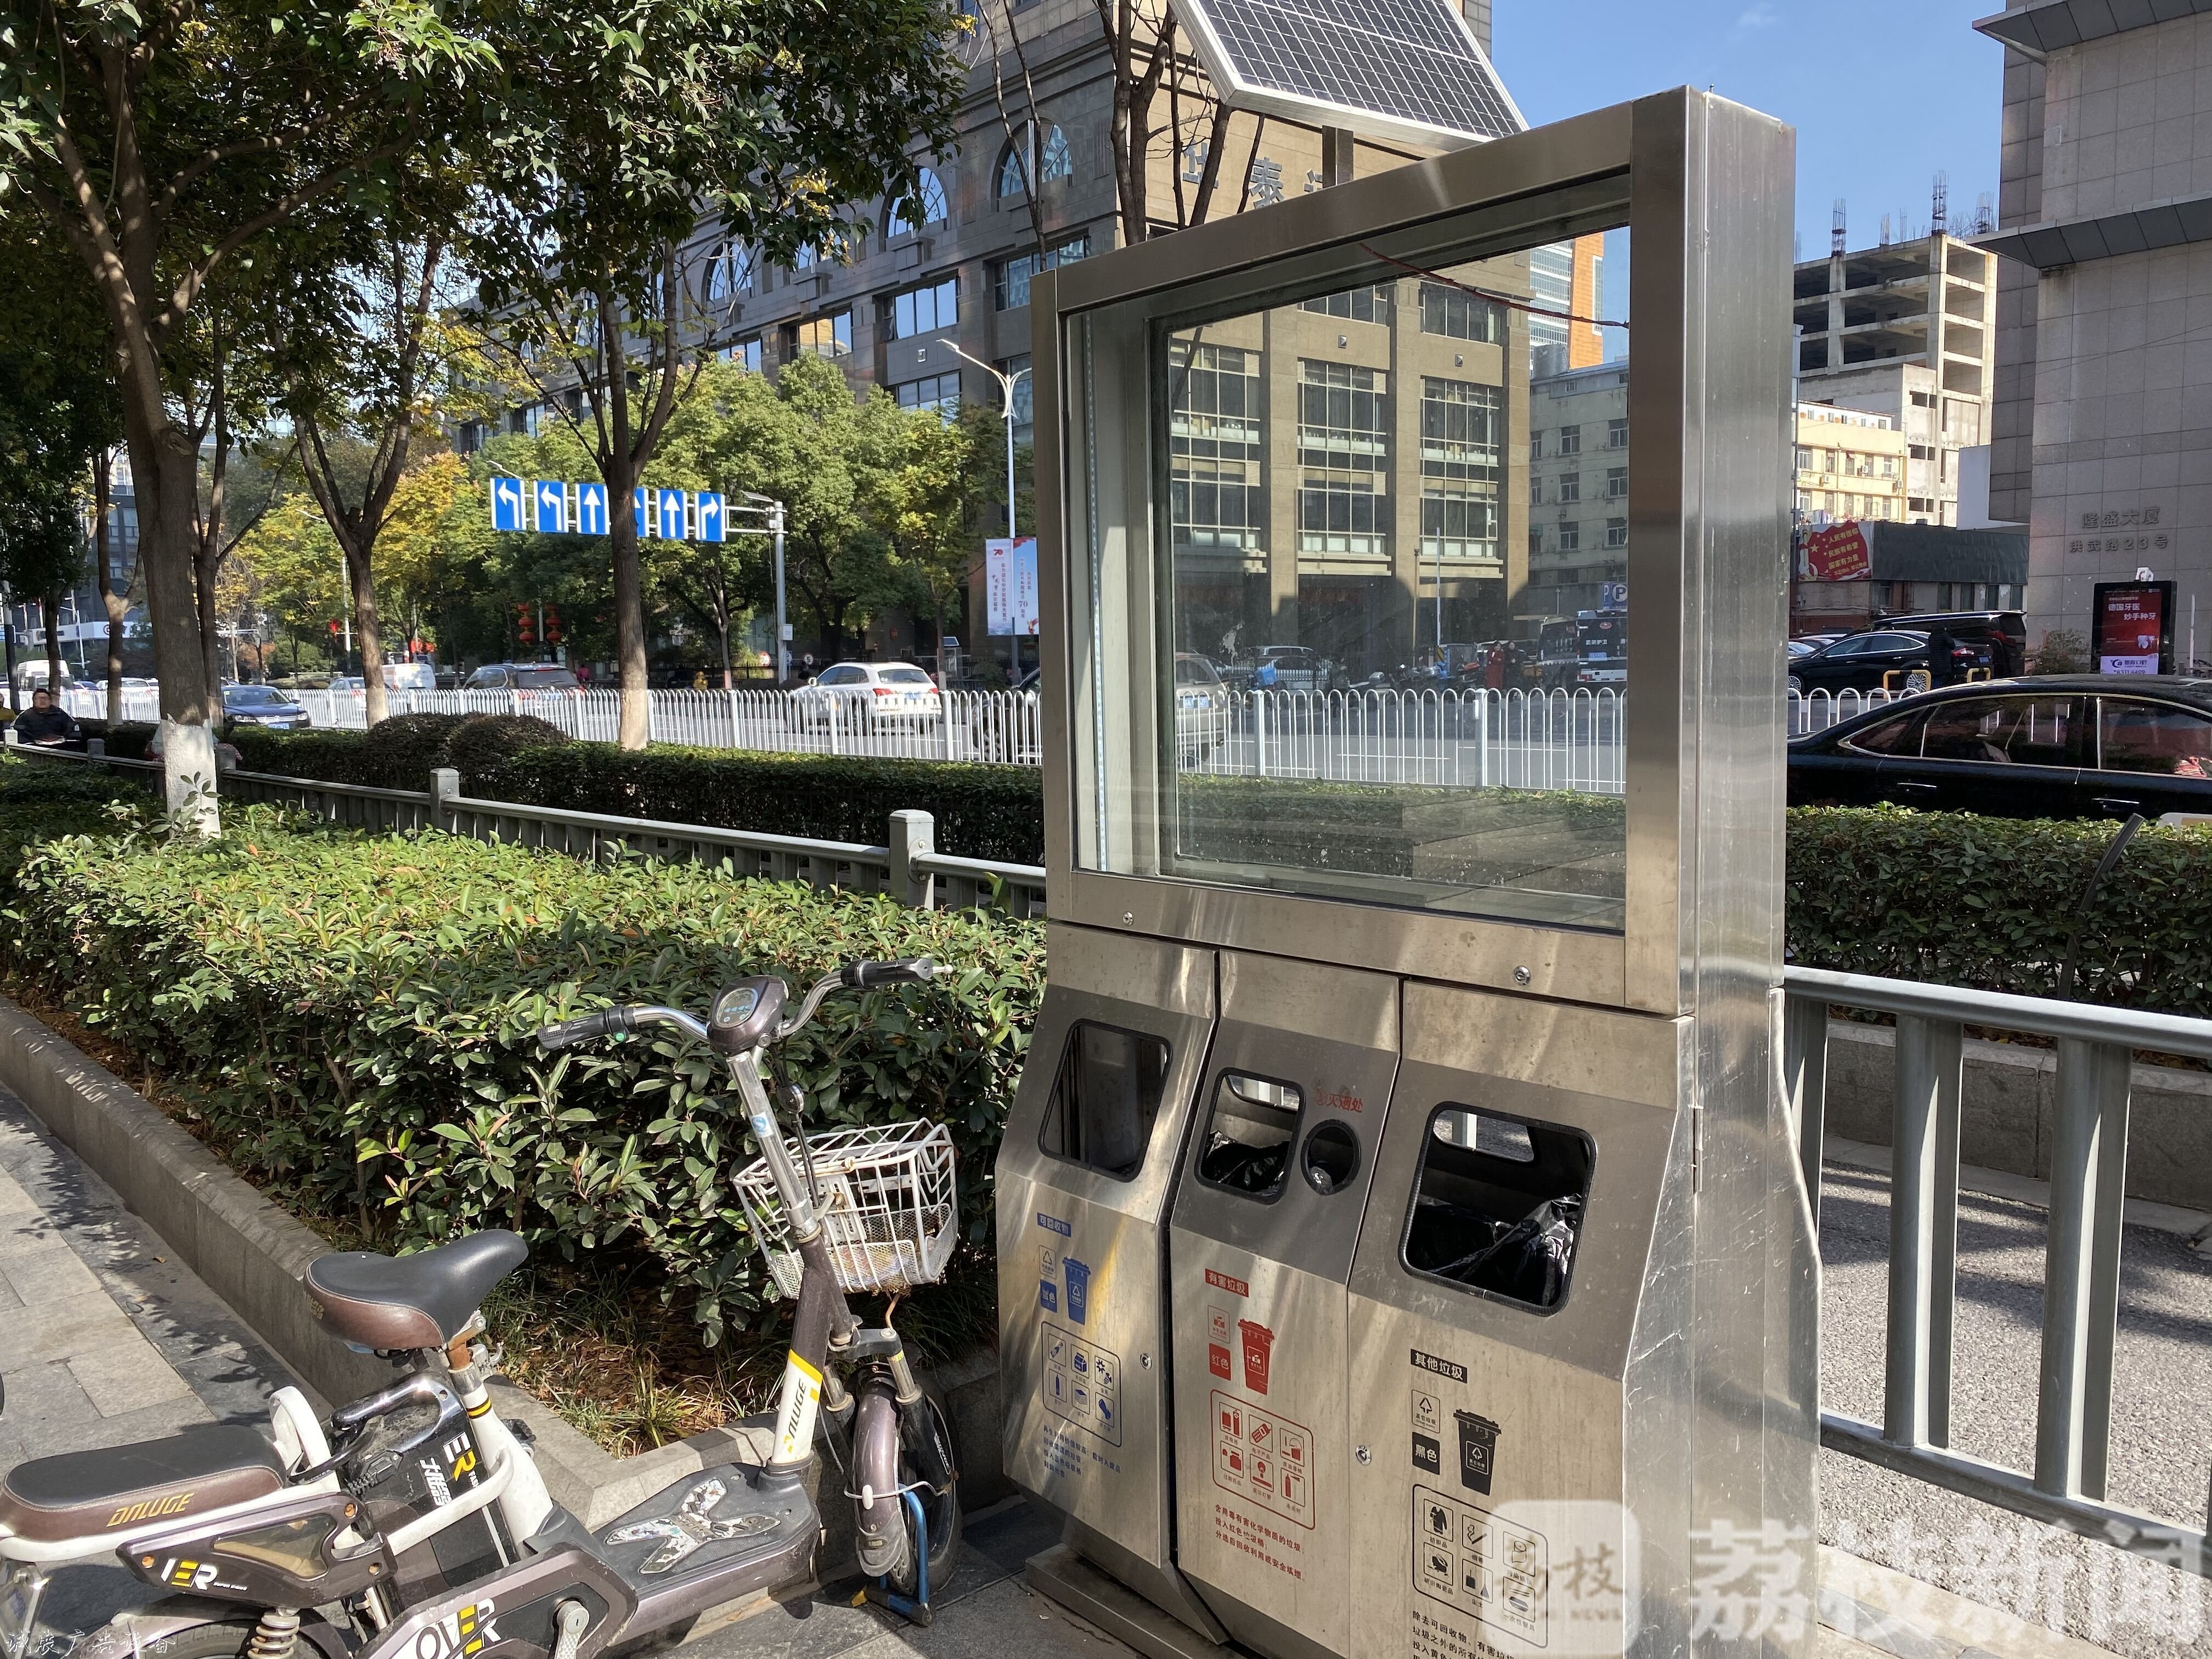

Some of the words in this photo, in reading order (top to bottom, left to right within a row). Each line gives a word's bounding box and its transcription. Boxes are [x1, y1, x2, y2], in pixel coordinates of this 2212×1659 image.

[1183, 139, 1323, 210] 华泰
[2082, 506, 2159, 528] 隆盛大厦
[1829, 528, 1859, 544] 人民有信仰
[2070, 535, 2168, 552] 洪武路23号
[1828, 541, 1859, 557] 民族有希望
[1828, 554, 1859, 569] 国家有力量
[1604, 585, 1609, 602] P
[1615, 587, 1627, 599] P
[2124, 612, 2157, 620] 妙手种牙
[1040, 1215, 1069, 1234] 可回收物
[1209, 1272, 1246, 1295] 有害垃圾
[1211, 1354, 1229, 1370] 红色
[1415, 1352, 1463, 1380] 其他垃圾
[1252, 1447, 1271, 1459] 电子产品
[1415, 1443, 1437, 1463] 黑色
[1223, 1474, 1242, 1487] 过期药品
[1430, 1536, 1448, 1549] 纺织品
[1503, 1614, 1535, 1632] 一次性餐具
